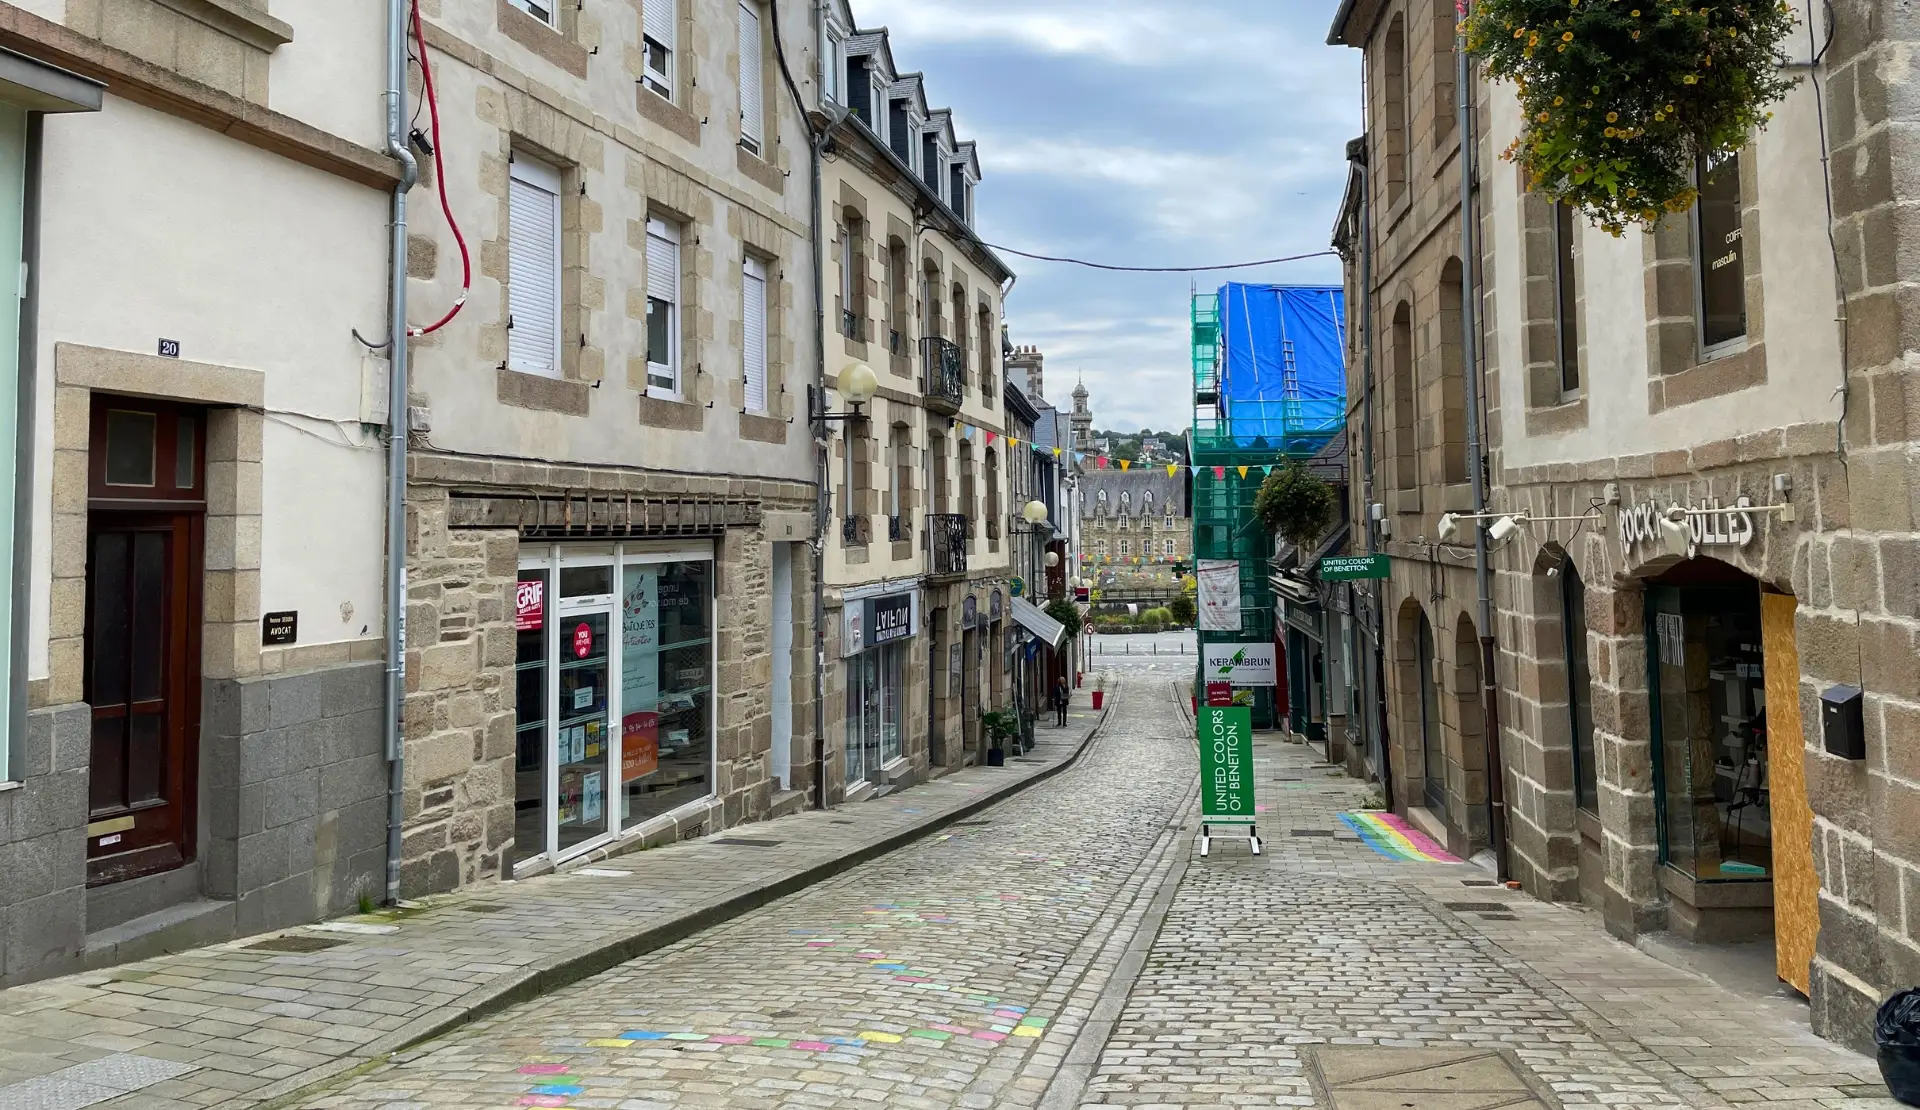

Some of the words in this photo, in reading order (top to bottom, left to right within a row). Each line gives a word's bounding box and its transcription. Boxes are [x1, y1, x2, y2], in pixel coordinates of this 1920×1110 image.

[162, 341, 176, 355] 20
[1348, 557, 1375, 565] COLORS
[270, 626, 292, 636] AVOCAT
[577, 630, 588, 639] YOU
[1209, 657, 1271, 667] KERAMBRUN
[1212, 709, 1226, 763] COLORS
[1226, 722, 1240, 789] BENETTON.
[1215, 767, 1228, 811] UNITED
[1230, 793, 1241, 811] OF
